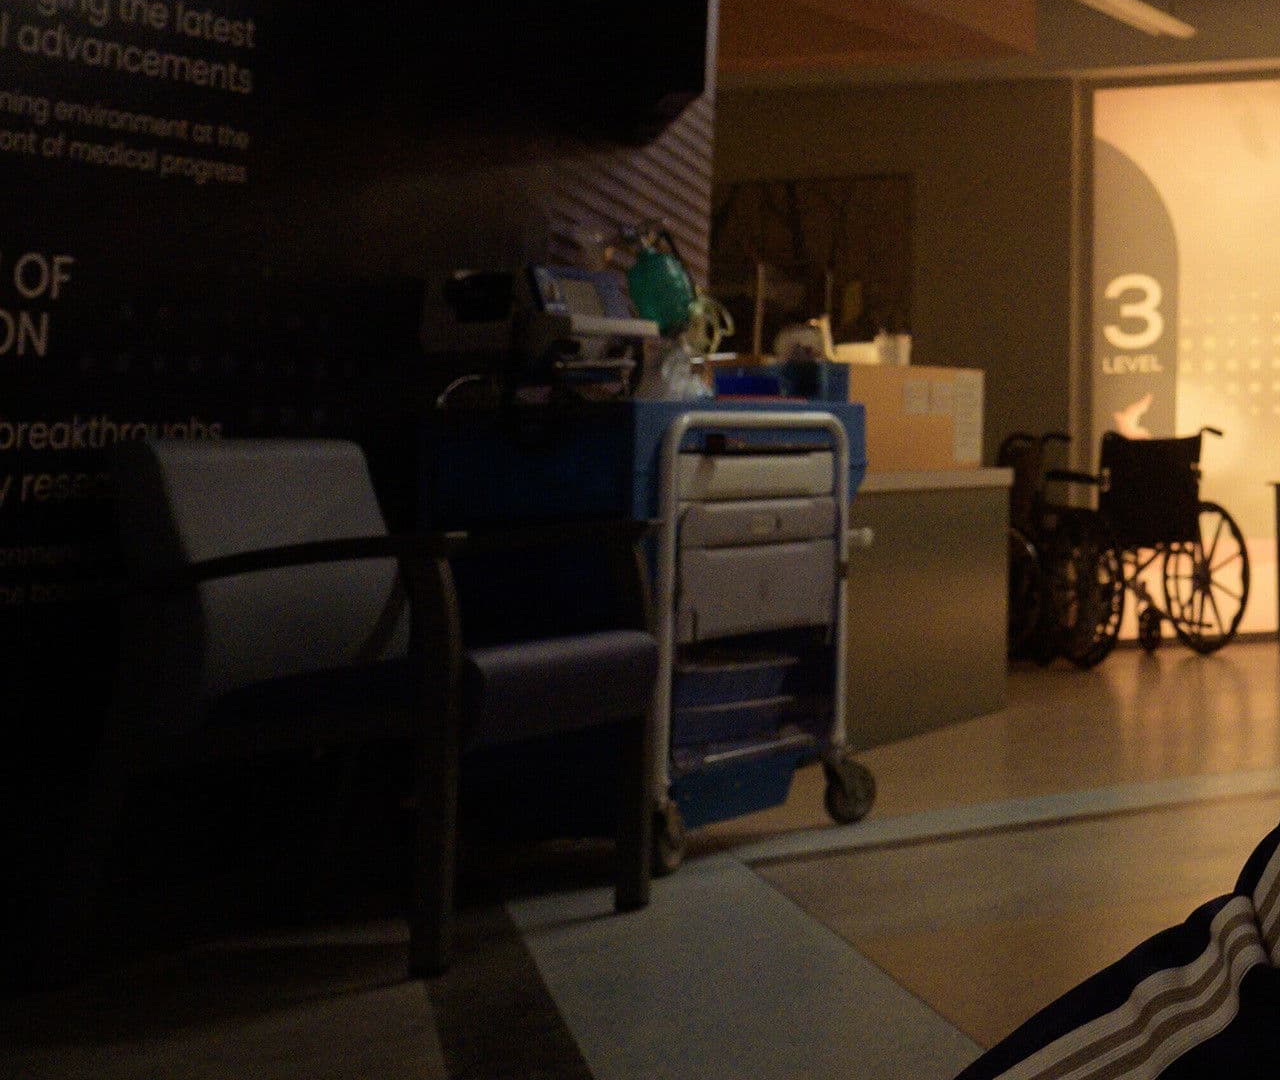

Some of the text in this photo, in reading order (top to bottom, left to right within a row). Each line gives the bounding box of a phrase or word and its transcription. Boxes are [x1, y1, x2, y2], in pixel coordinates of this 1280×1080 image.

[175, 0, 258, 49] latest
[17, 22, 254, 96] advancements
[53, 99, 189, 140] environment
[68, 139, 159, 172] medical
[159, 153, 249, 186] progress
[14, 252, 77, 301] OF
[1103, 272, 1164, 350] 3
[1102, 353, 1163, 375] LEVEL
